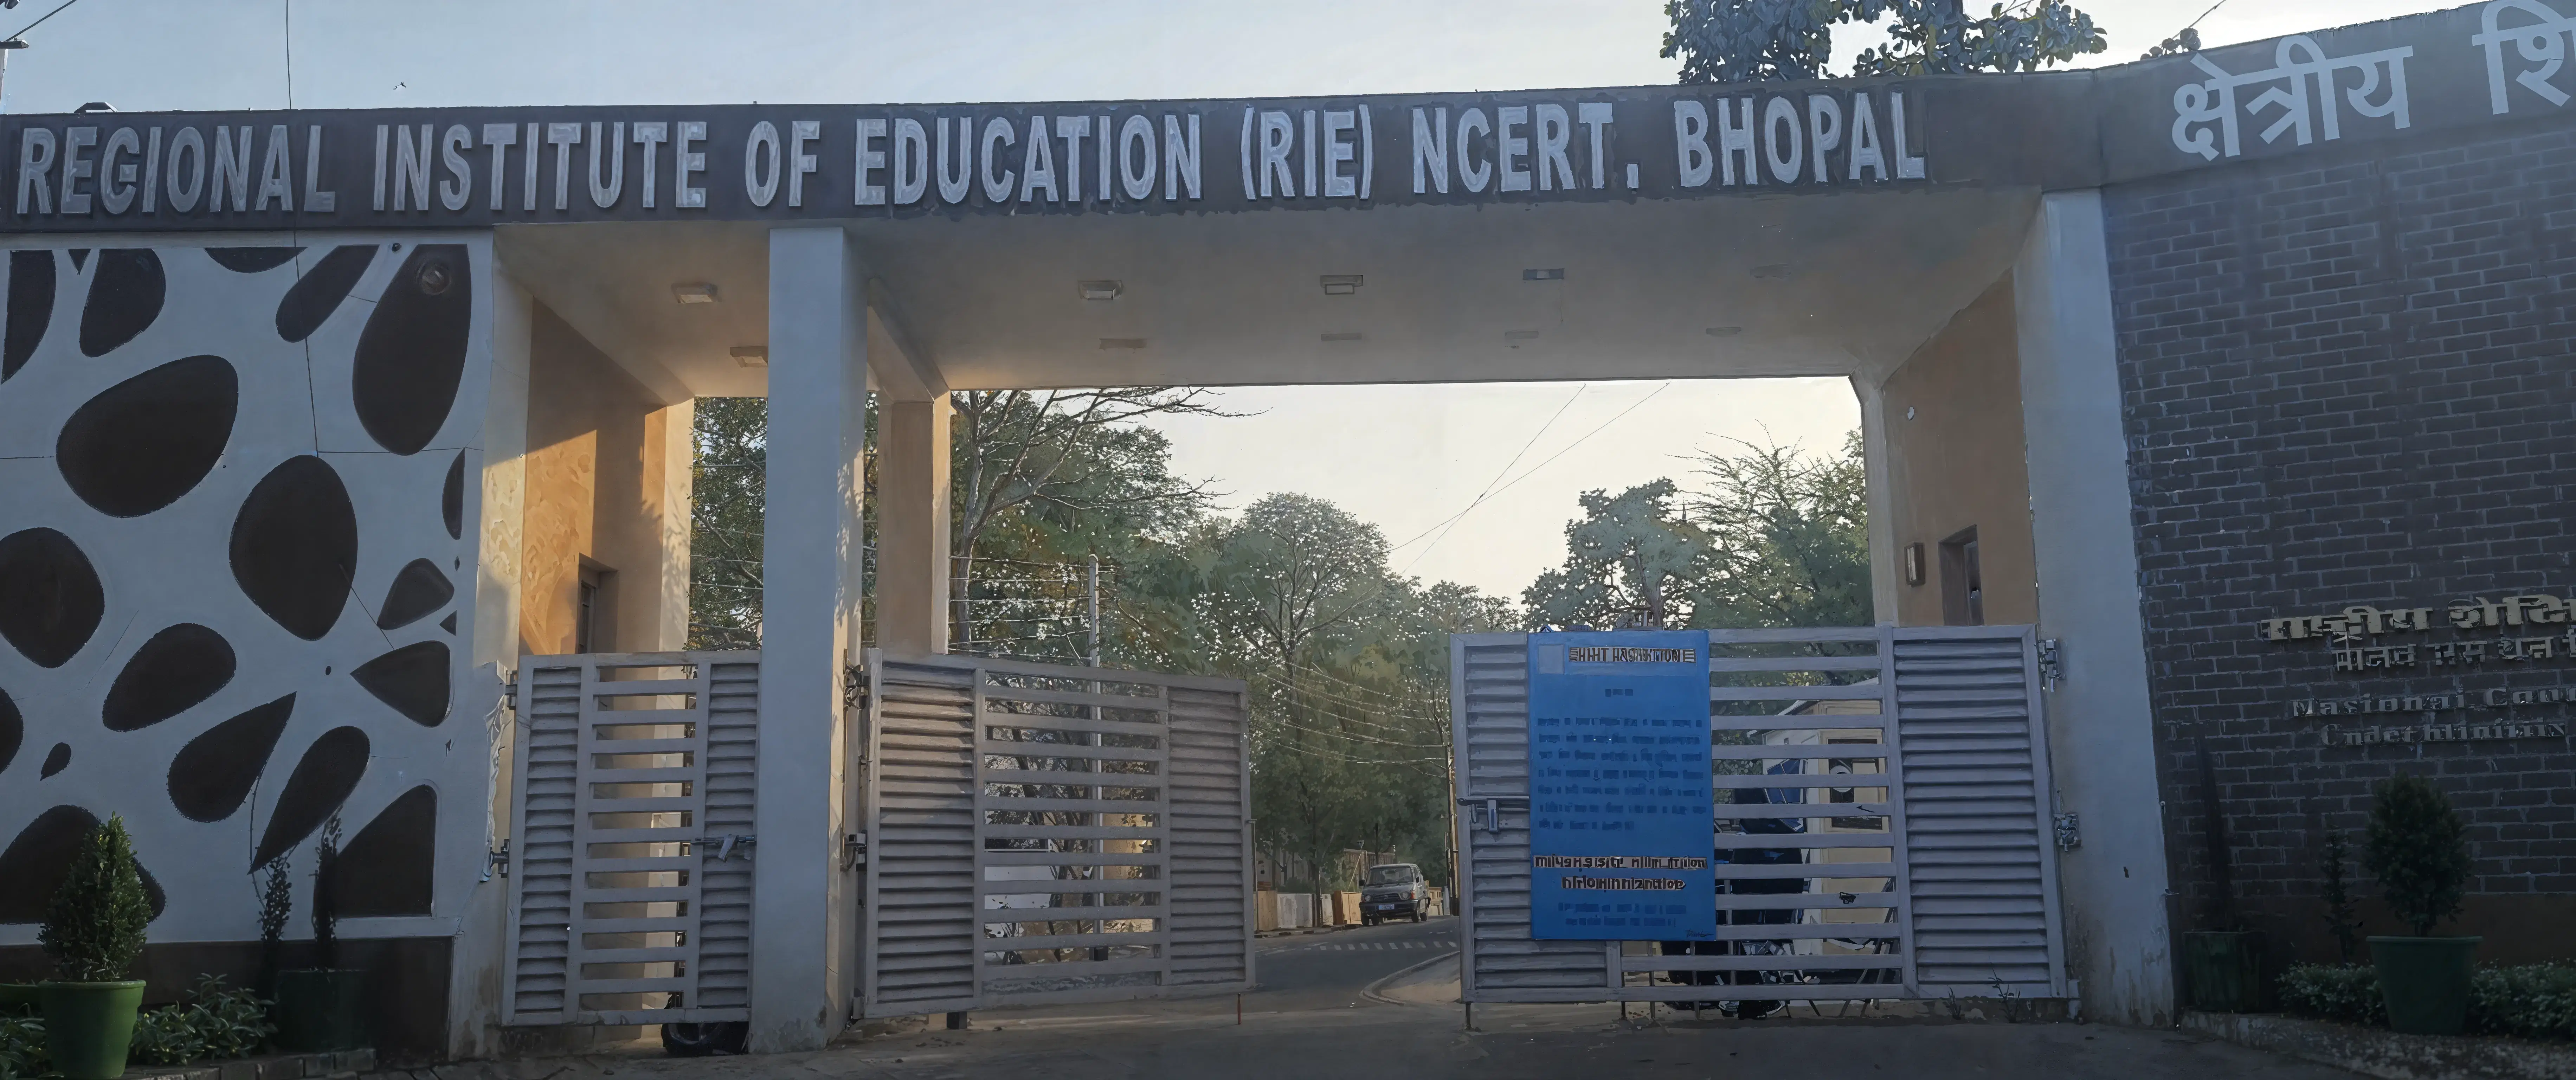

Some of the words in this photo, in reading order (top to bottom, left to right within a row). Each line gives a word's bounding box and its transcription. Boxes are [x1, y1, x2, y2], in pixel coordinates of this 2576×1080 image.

[17, 125, 335, 214] REGIONAL
[373, 121, 707, 211] INSTITUTE
[745, 121, 820, 207] OF
[855, 114, 1202, 205] EDUCATION
[1241, 104, 1373, 200] (RIE)
[1674, 92, 1926, 188] BHOPAL
[2172, 34, 2413, 161] क्षेत्रीय
